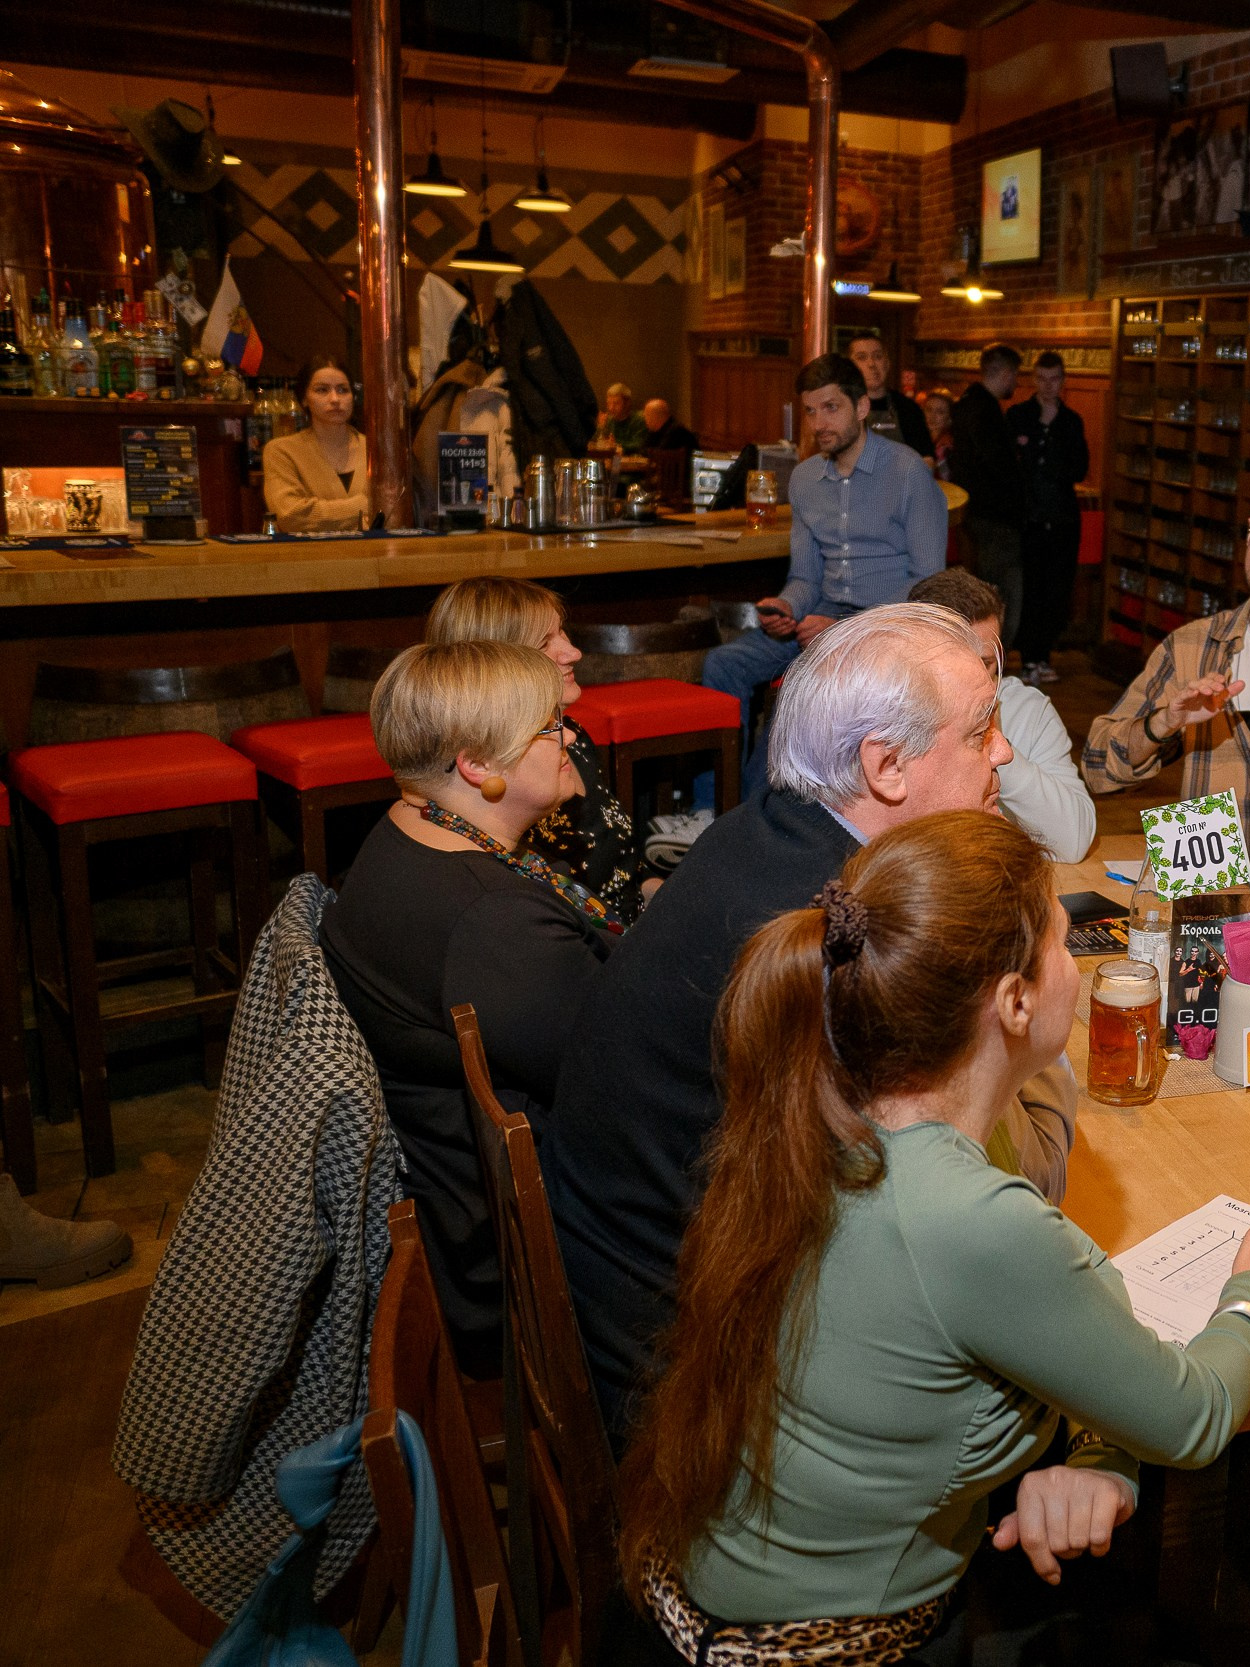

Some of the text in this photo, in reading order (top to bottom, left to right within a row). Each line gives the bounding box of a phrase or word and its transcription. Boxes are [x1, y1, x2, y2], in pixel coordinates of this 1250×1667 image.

[441, 448, 467, 457] ПОСЛЕ
[460, 458, 486, 469] 1+1=3
[1178, 823, 1197, 835] СТОЛ
[1172, 832, 1226, 872] 400
[1180, 924, 1222, 938] Король
